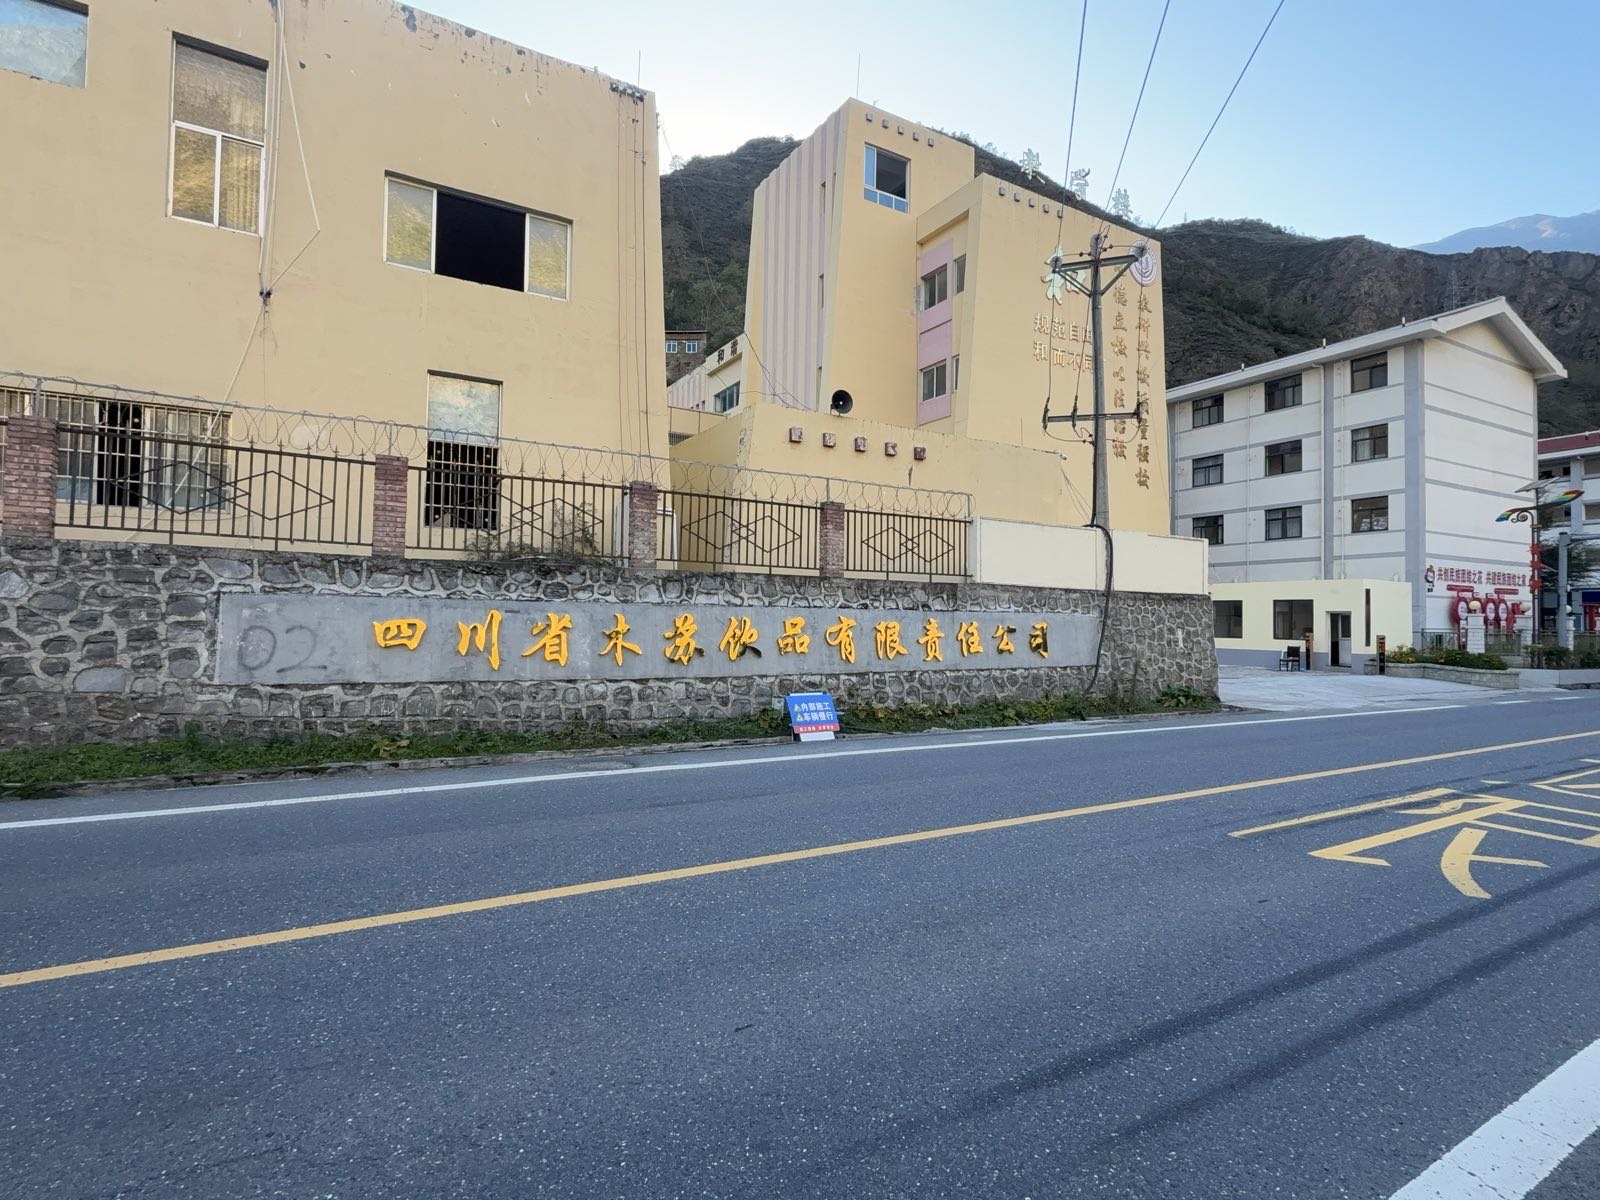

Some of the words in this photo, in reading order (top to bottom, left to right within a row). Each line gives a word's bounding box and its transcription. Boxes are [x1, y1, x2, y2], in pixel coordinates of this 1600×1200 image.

[372, 609, 1049, 671] 四川省木苏饮品有限责任公司
